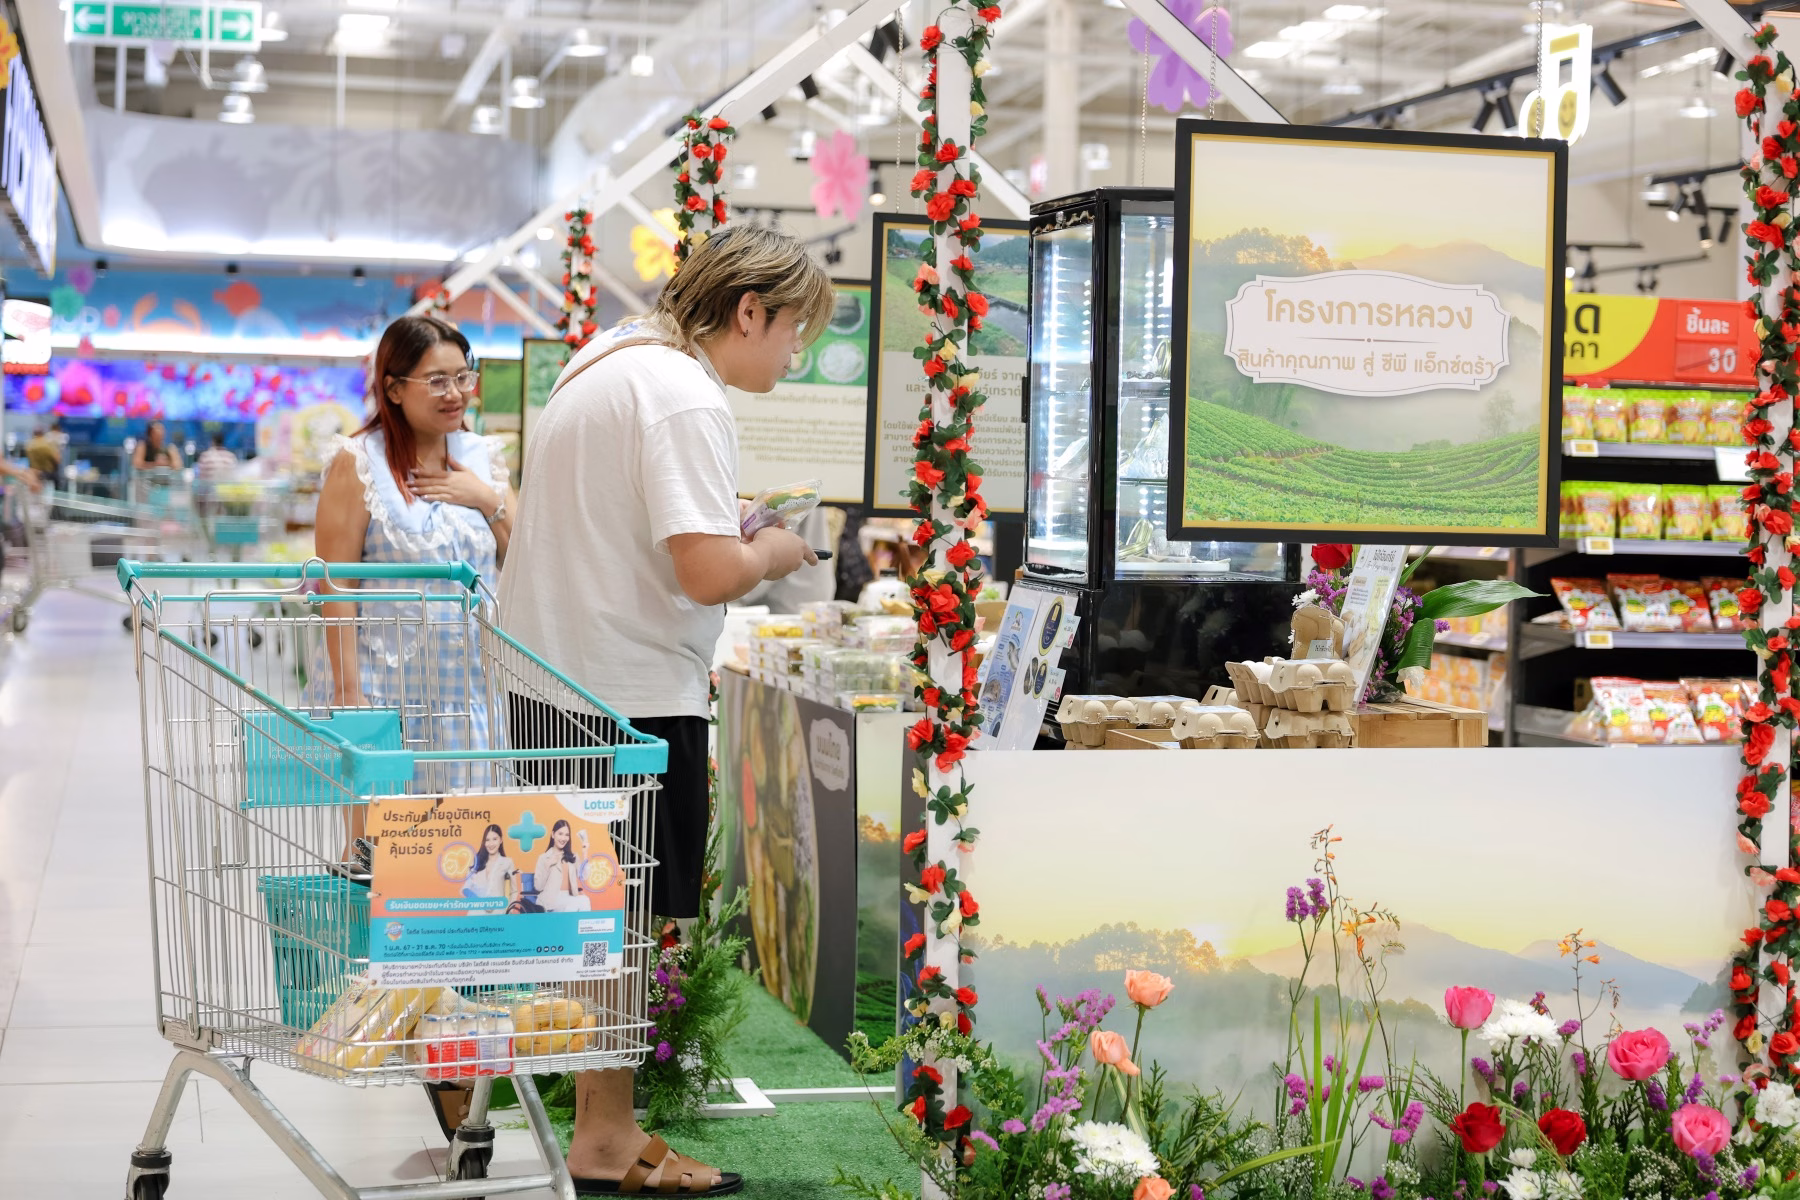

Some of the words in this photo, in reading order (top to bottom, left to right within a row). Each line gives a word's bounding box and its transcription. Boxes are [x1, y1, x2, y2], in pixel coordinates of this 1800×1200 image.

[1264, 288, 1473, 330] โครงการหลวง
[1564, 304, 1600, 335] ด
[1686, 307, 1730, 335] ชิ้นละ
[1238, 348, 1356, 375] สินค้าคุณภาพ
[1363, 351, 1375, 377] สู่
[1381, 353, 1407, 374] ซีพี
[1414, 351, 1495, 376] แอ็กซ์ตร้า
[1563, 341, 1600, 359] คา
[1708, 347, 1737, 375] 30
[906, 383, 927, 393] และ
[584, 799, 625, 810] Lotus's
[389, 842, 433, 859] คุ้มเว่อร์
